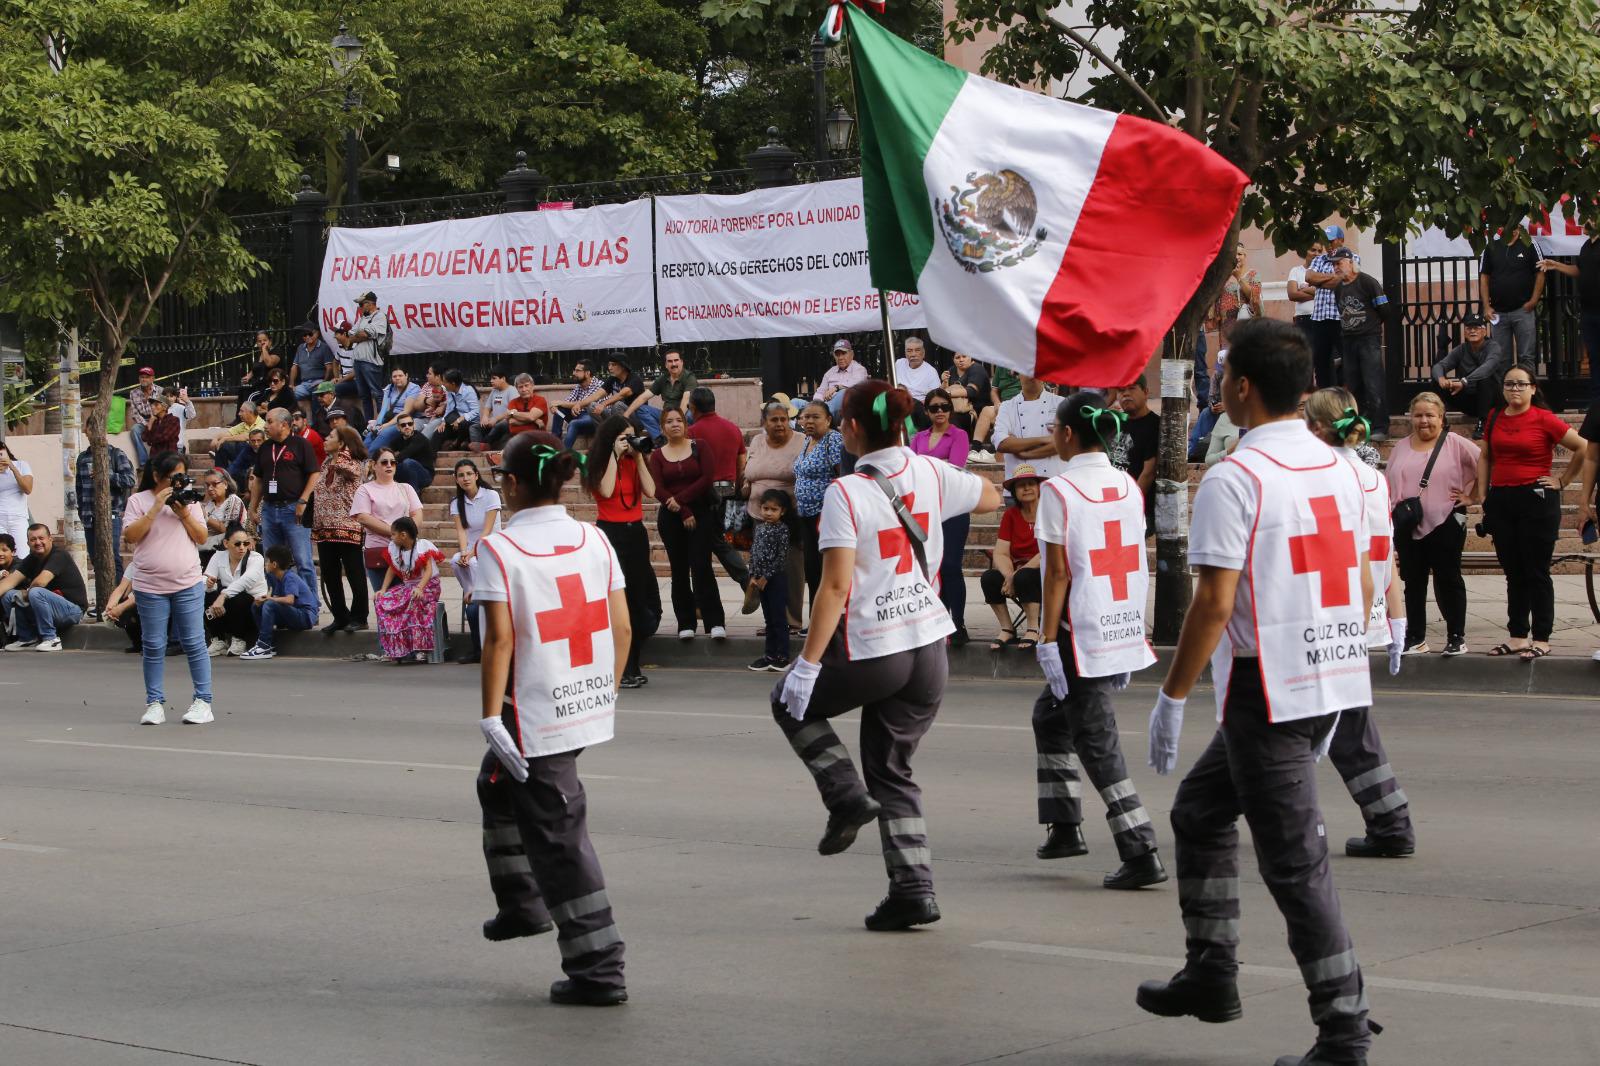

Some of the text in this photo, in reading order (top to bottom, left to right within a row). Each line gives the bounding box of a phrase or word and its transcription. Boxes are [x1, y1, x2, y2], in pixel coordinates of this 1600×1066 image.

[721, 214, 765, 232] FORENSE
[767, 212, 794, 228] POR
[797, 209, 815, 225] LA
[817, 204, 860, 224] UNIDAD
[331, 236, 629, 281] FURA MADUEÑA DE LA UAS
[661, 262, 706, 278] RESPETO
[707, 262, 715, 276] A
[715, 261, 737, 276] LOS
[739, 256, 803, 275] DERECHOS
[807, 254, 829, 270] DEL
[322, 306, 347, 332] NO
[403, 291, 565, 329] REINGENIERÍA
[665, 292, 920, 321] RECHAZAMOS APLICACIÓN DE LEYES REROAC
[875, 587, 905, 606] CRUZ
[1100, 609, 1142, 627] CRUZ ROJA
[1102, 625, 1142, 643] MEXICANA
[1303, 624, 1334, 643] CUZ
[552, 673, 614, 700] CRUZ ROJA
[555, 691, 615, 719] MEXICANA
